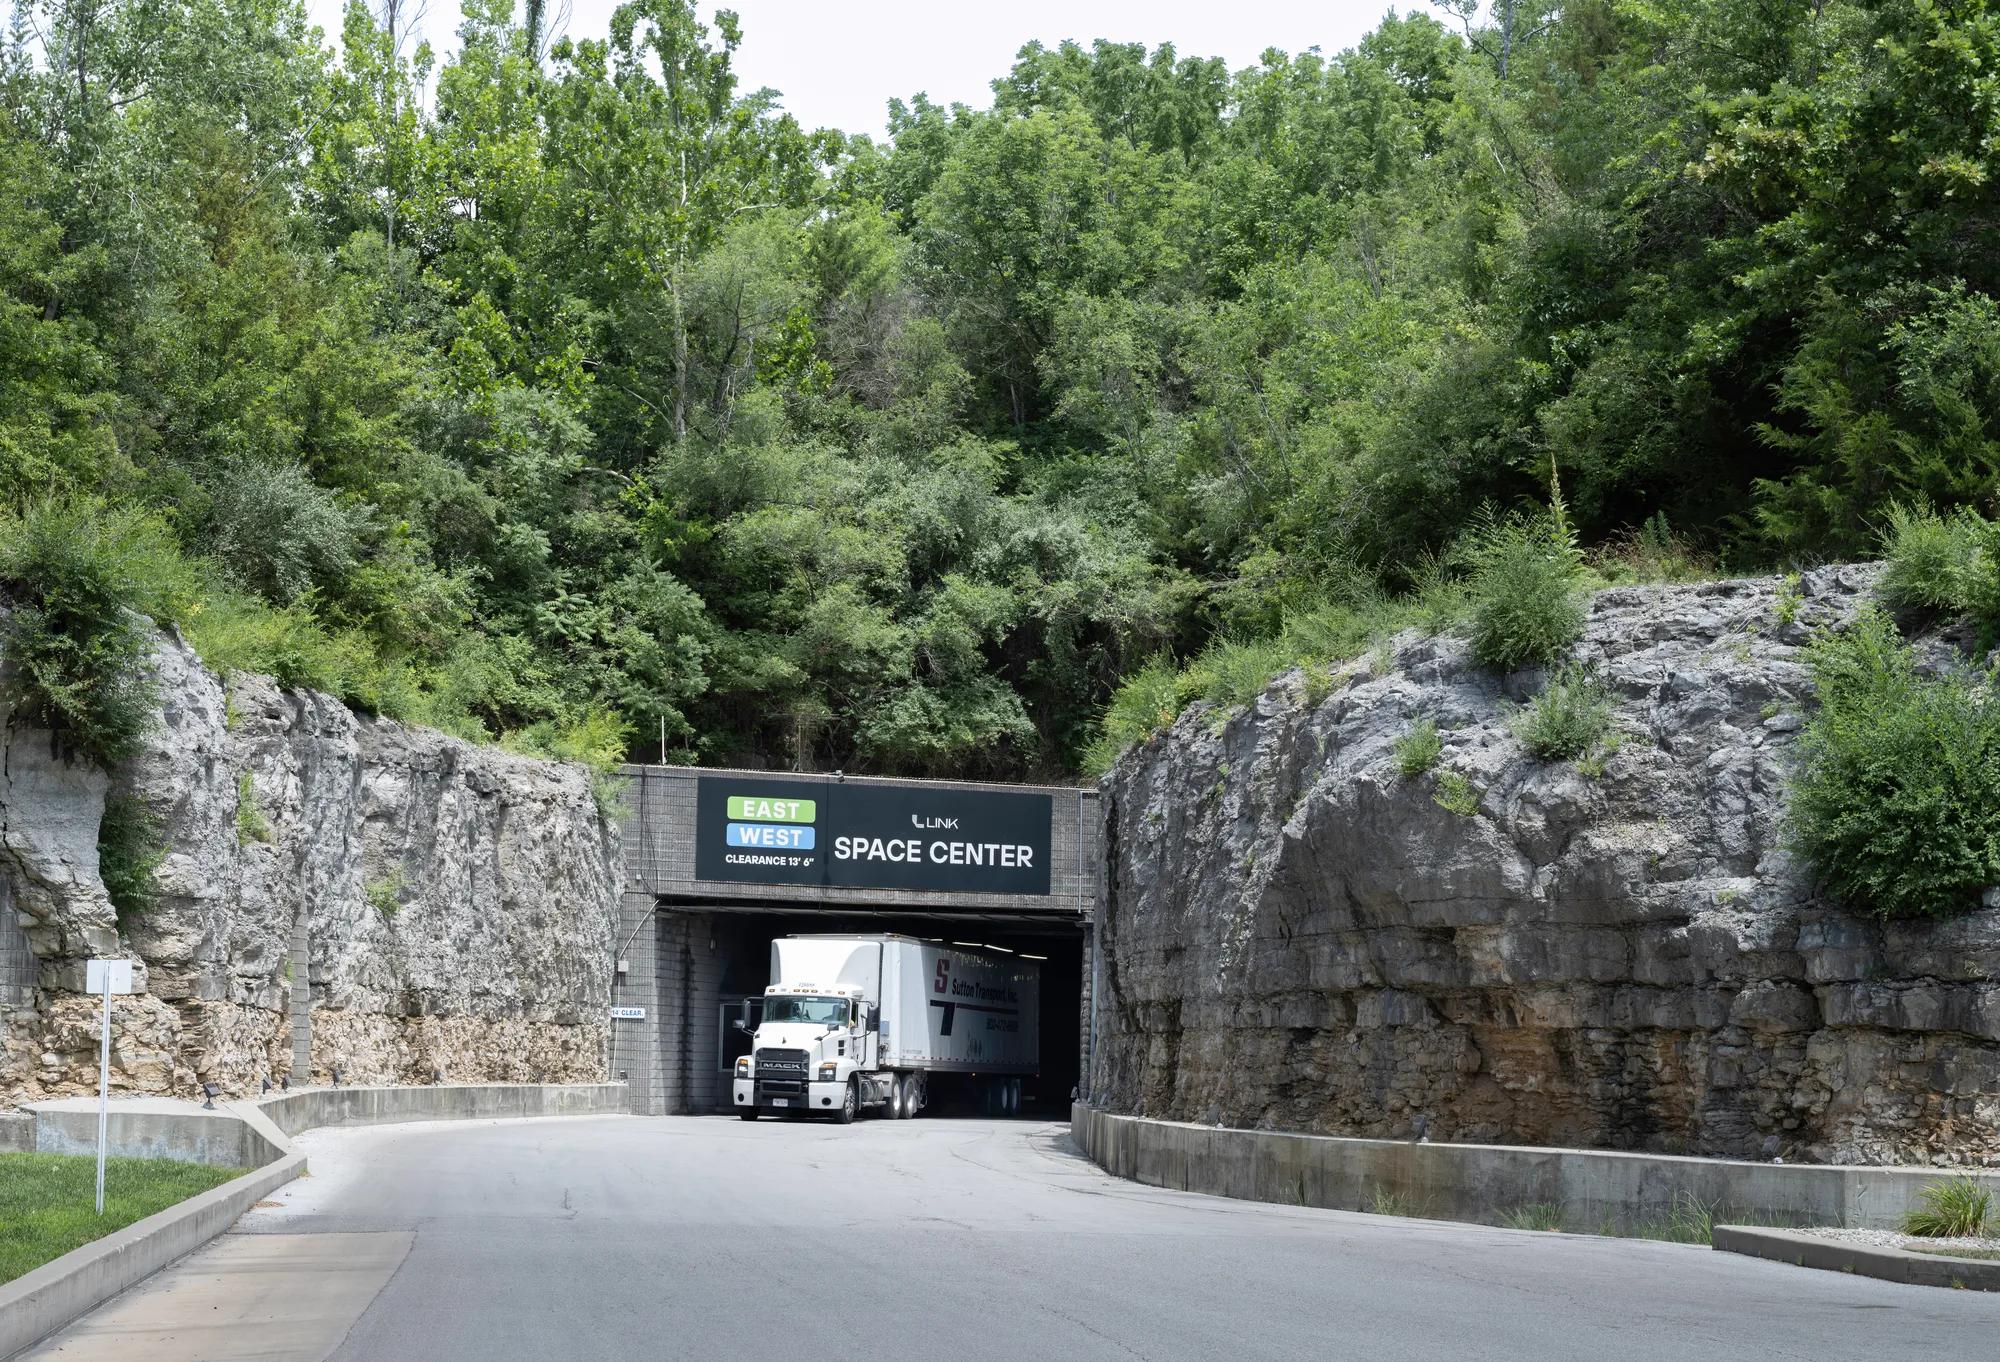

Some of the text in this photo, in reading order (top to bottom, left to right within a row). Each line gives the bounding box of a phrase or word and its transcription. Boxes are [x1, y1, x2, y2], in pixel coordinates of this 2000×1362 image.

[743, 800, 800, 819] EAST
[926, 817, 959, 829] LINK
[740, 827, 803, 846] WEST
[725, 854, 787, 866] CLEARANCE
[834, 836, 1033, 867] SPACE CENTER
[952, 978, 975, 998] Sutton
